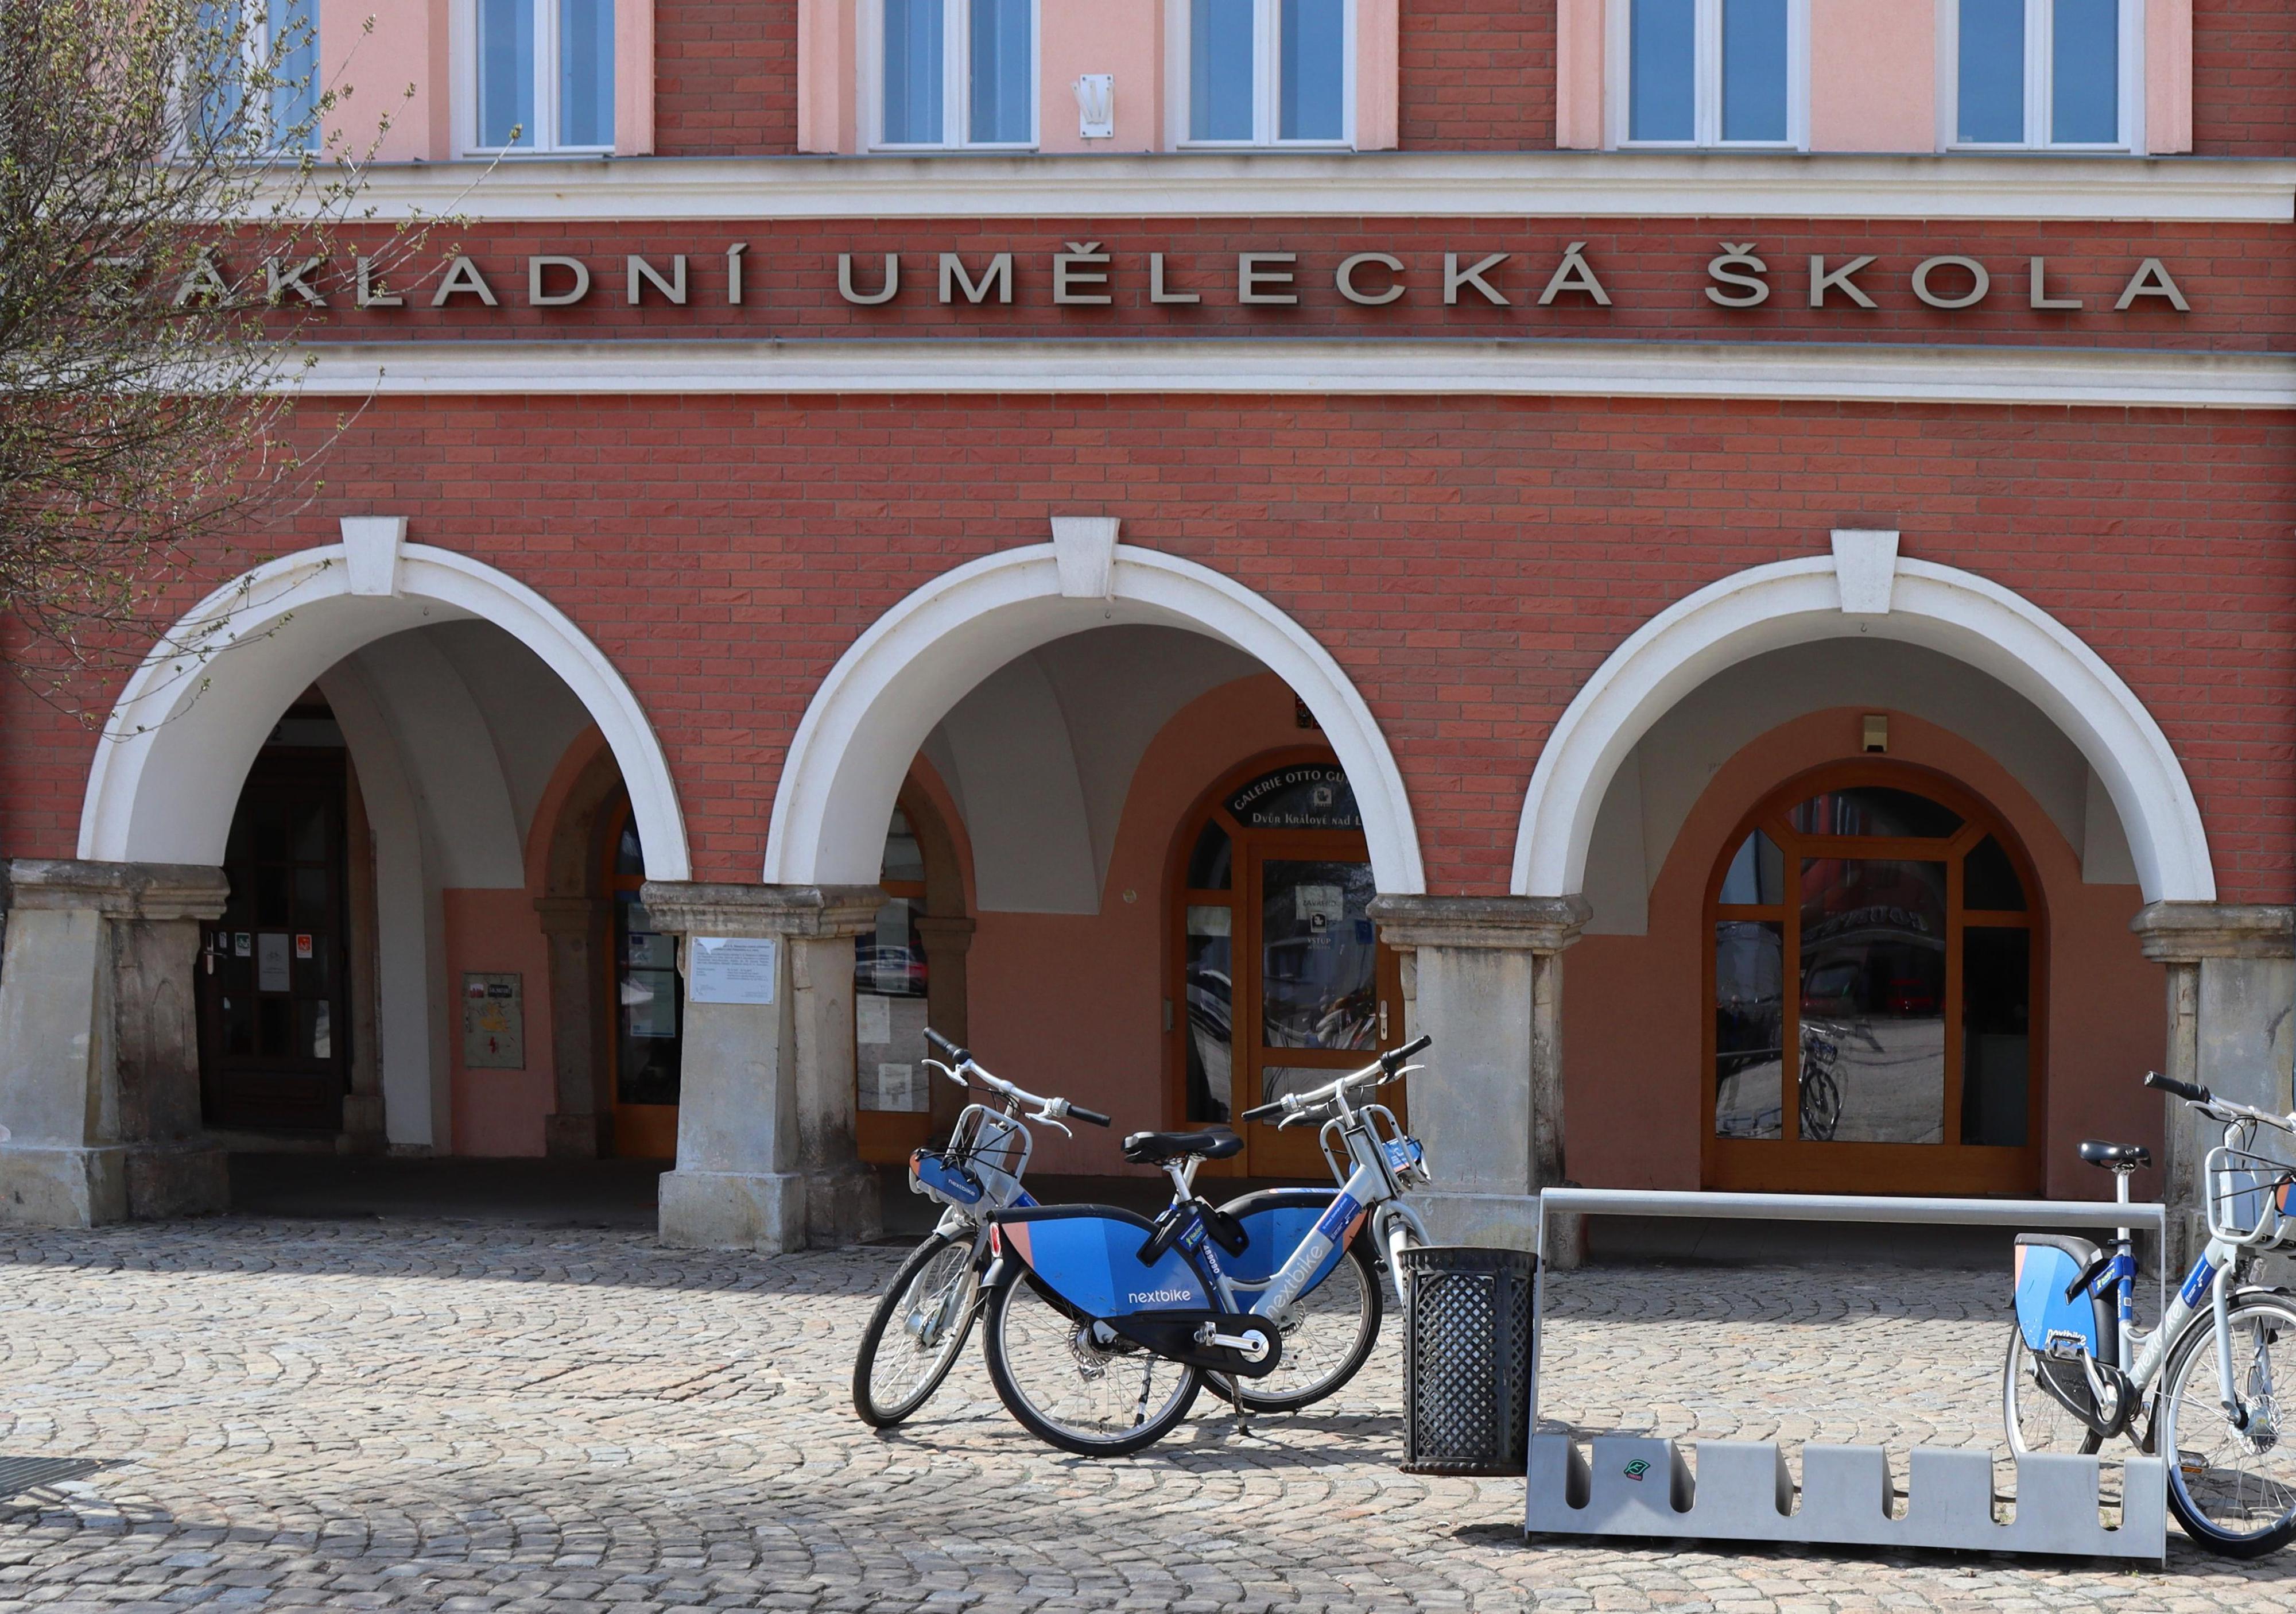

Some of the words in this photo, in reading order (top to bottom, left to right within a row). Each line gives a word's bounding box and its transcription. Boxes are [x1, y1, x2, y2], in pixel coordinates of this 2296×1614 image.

[90, 242, 750, 308] ZÁKLADNÍ
[837, 241, 1612, 306] UMĚLECKÁ
[1705, 242, 2191, 311] ŠKOLA
[1234, 776, 1282, 811] GALERIE
[1286, 770, 1321, 783] OTTO
[1325, 771, 1349, 785] GU
[1355, 815, 1362, 826] L
[948, 1179, 976, 1197] nextbike
[1203, 1245, 1220, 1274] 489090
[1128, 1289, 1191, 1303] nextbike
[1265, 1245, 1323, 1319] nextbike
